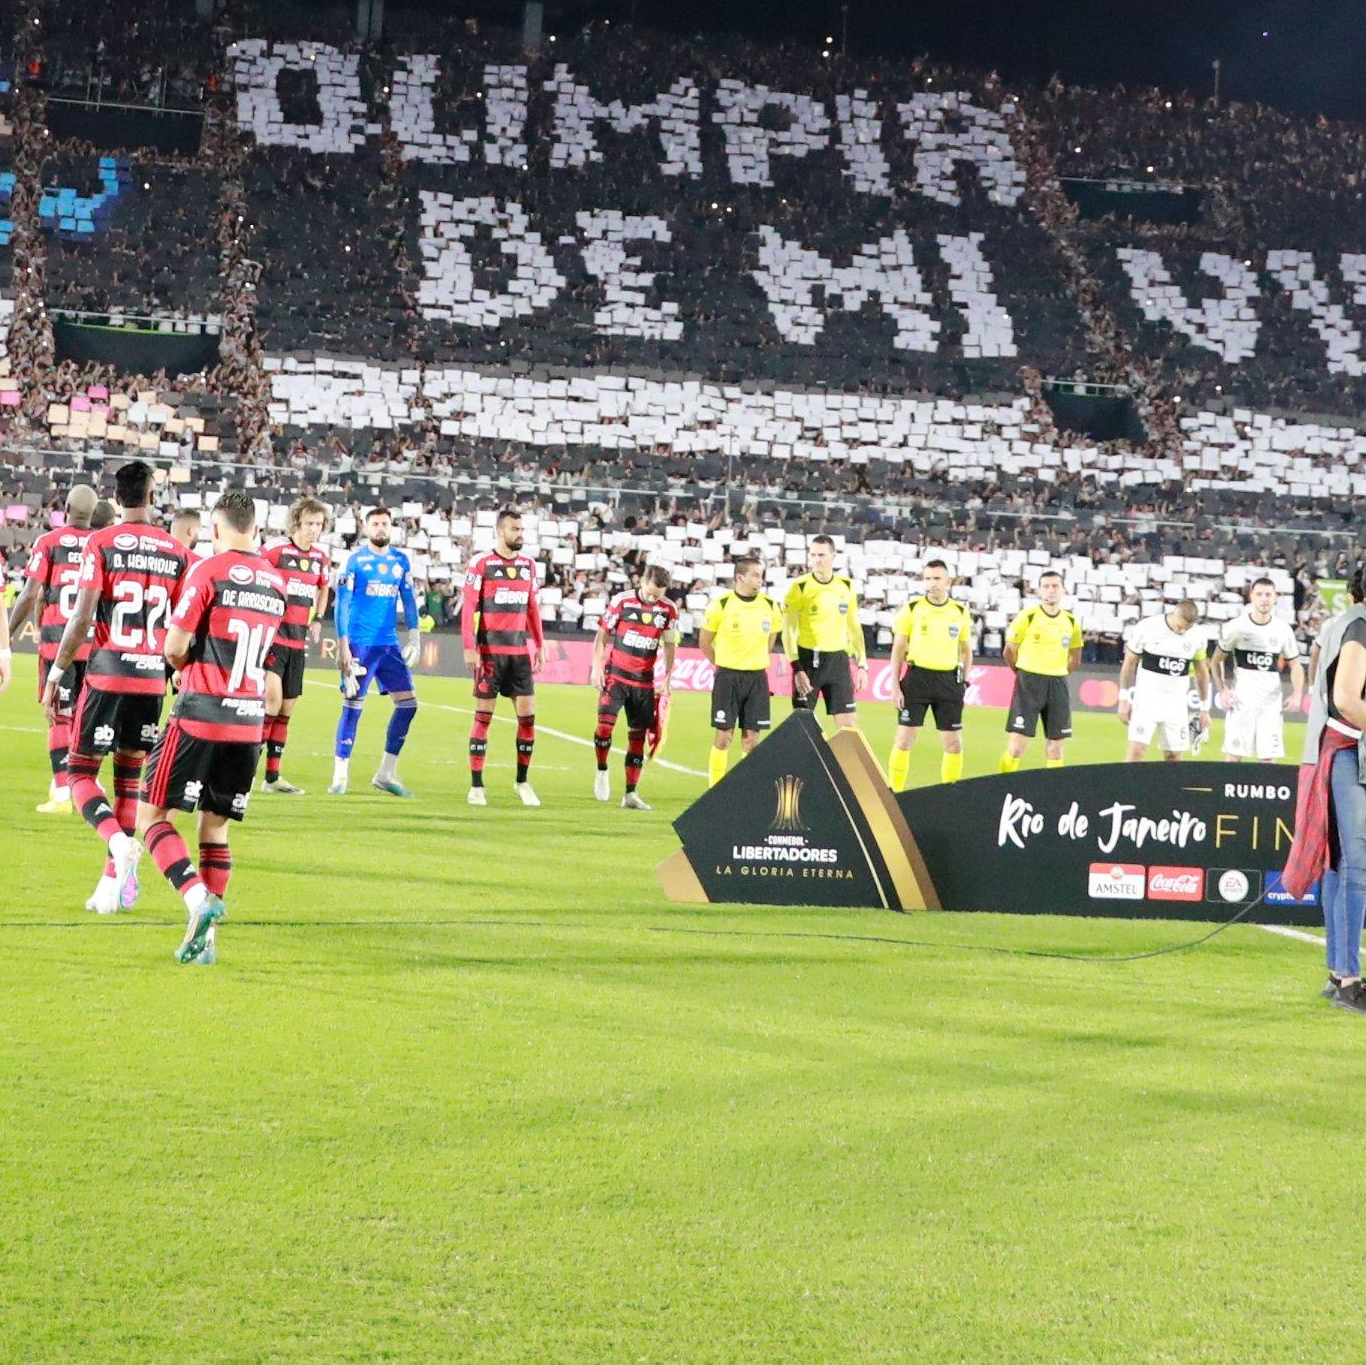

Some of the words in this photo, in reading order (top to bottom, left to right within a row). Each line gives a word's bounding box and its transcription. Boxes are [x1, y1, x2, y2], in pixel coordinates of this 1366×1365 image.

[227, 39, 1026, 206] OLIMPIA
[416, 190, 684, 340] DE
[752, 225, 1017, 359] MI
[127, 554, 179, 576] HENRIQUE
[221, 589, 236, 606] DE
[111, 580, 168, 651] 27
[227, 617, 277, 695] 14
[1224, 783, 1291, 800] RUMBO
[997, 792, 1045, 849] Rio
[1057, 800, 1089, 840] de
[1097, 801, 1207, 854] Janeiro
[732, 845, 838, 863] LIBERTADORES
[716, 865, 732, 876] LA
[741, 865, 794, 878] GLORIA
[802, 868, 854, 879] ETERNA
[1095, 883, 1138, 895] AMSTEL
[1149, 872, 1199, 895] Coca-Cola
